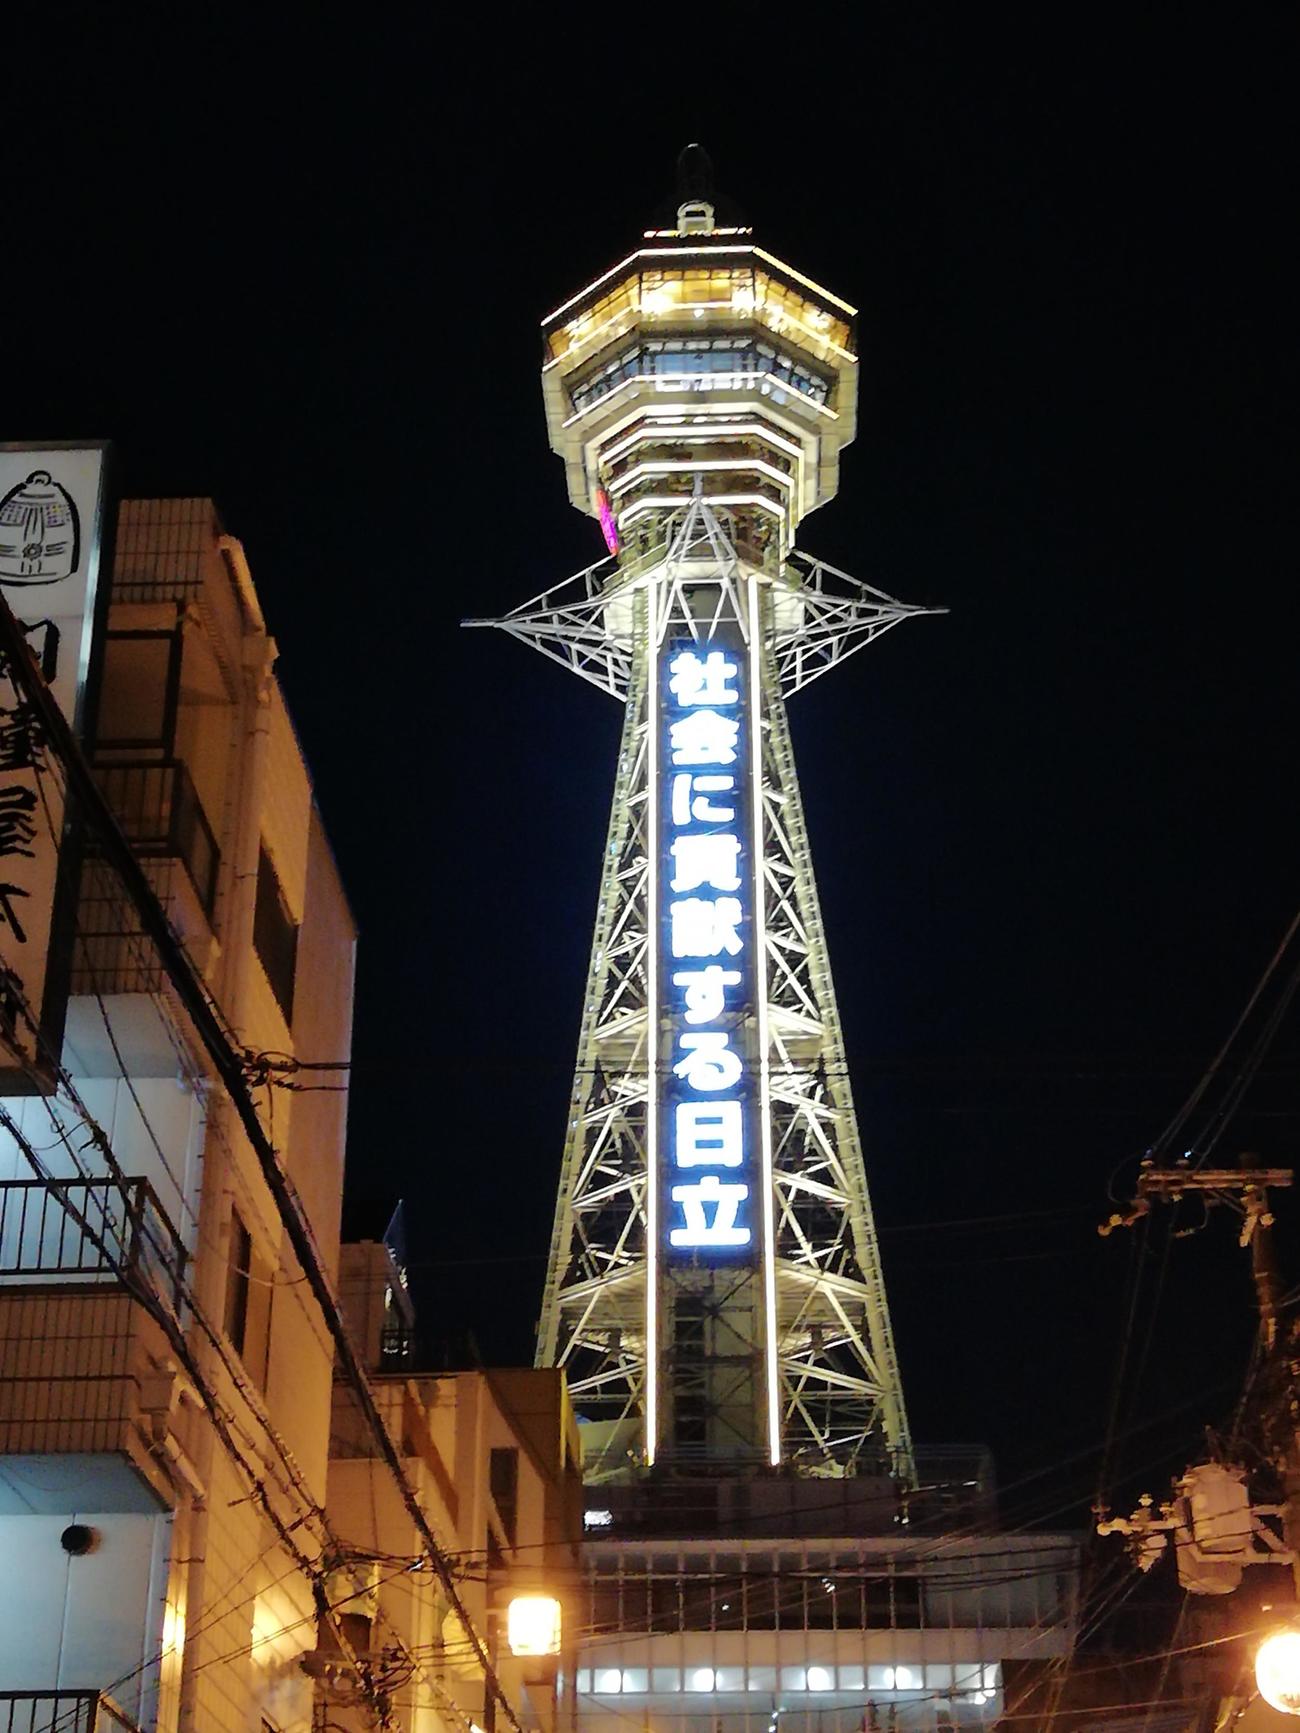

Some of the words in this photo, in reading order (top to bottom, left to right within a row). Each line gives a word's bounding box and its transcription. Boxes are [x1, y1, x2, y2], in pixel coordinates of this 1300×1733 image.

[669, 651, 751, 1246] 社会に貢献する日立
